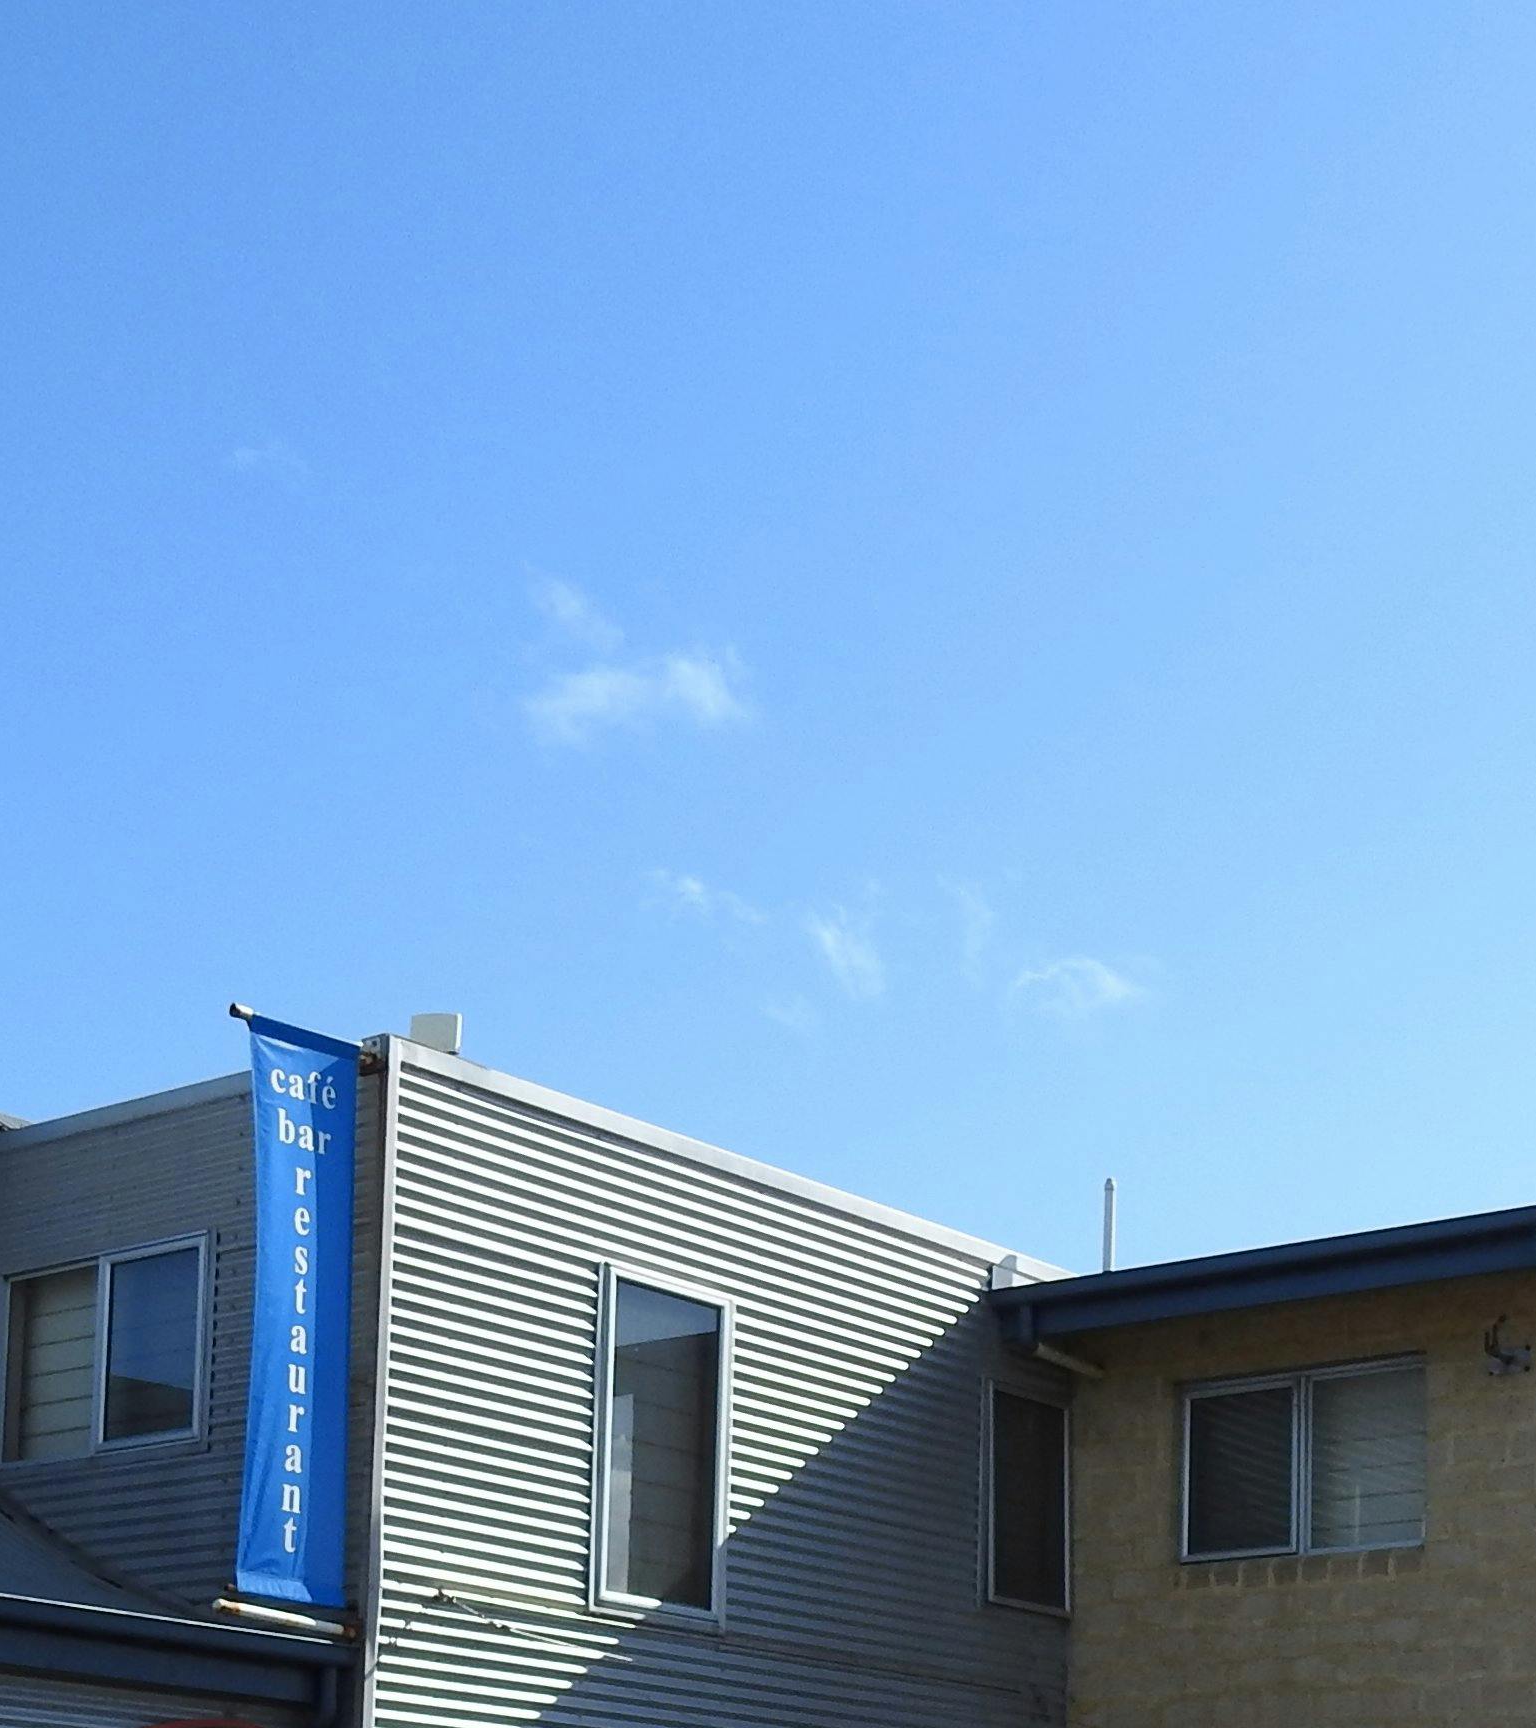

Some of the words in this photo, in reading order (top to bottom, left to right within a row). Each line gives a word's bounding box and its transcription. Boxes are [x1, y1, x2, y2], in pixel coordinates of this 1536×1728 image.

[270, 1069, 336, 1110] café
[277, 1107, 332, 1155] bar
[281, 1166, 312, 1553] restaurant
